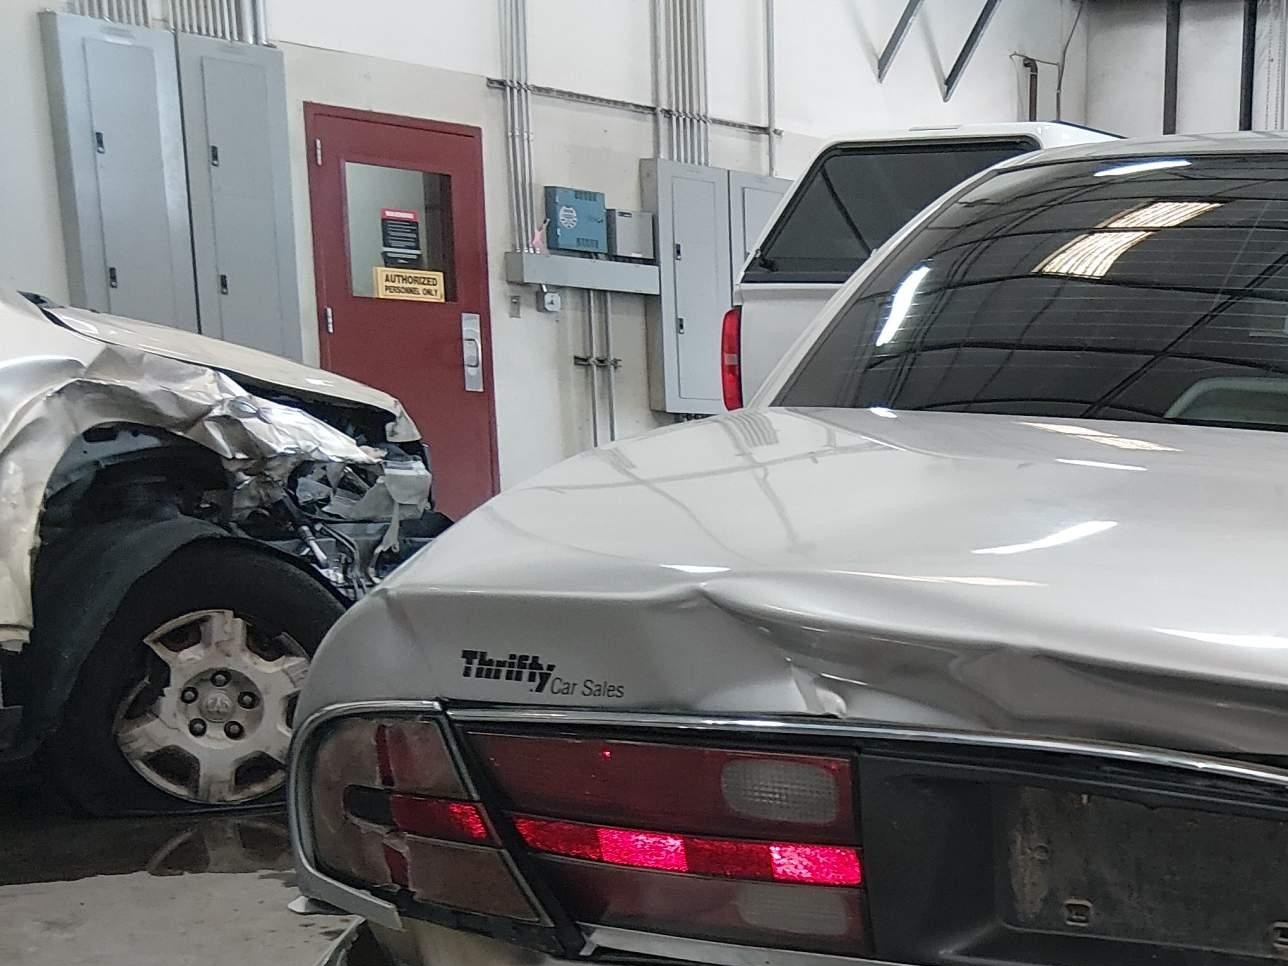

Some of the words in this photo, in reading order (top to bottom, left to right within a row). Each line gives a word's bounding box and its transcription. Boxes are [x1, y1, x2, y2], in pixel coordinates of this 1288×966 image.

[384, 273, 438, 287] AUTHORIZED
[384, 285, 421, 296] PERSONNEL
[422, 287, 438, 297] ONLY
[461, 649, 556, 693] Thrifty
[550, 677, 578, 695] Car
[582, 679, 625, 698] Sales
